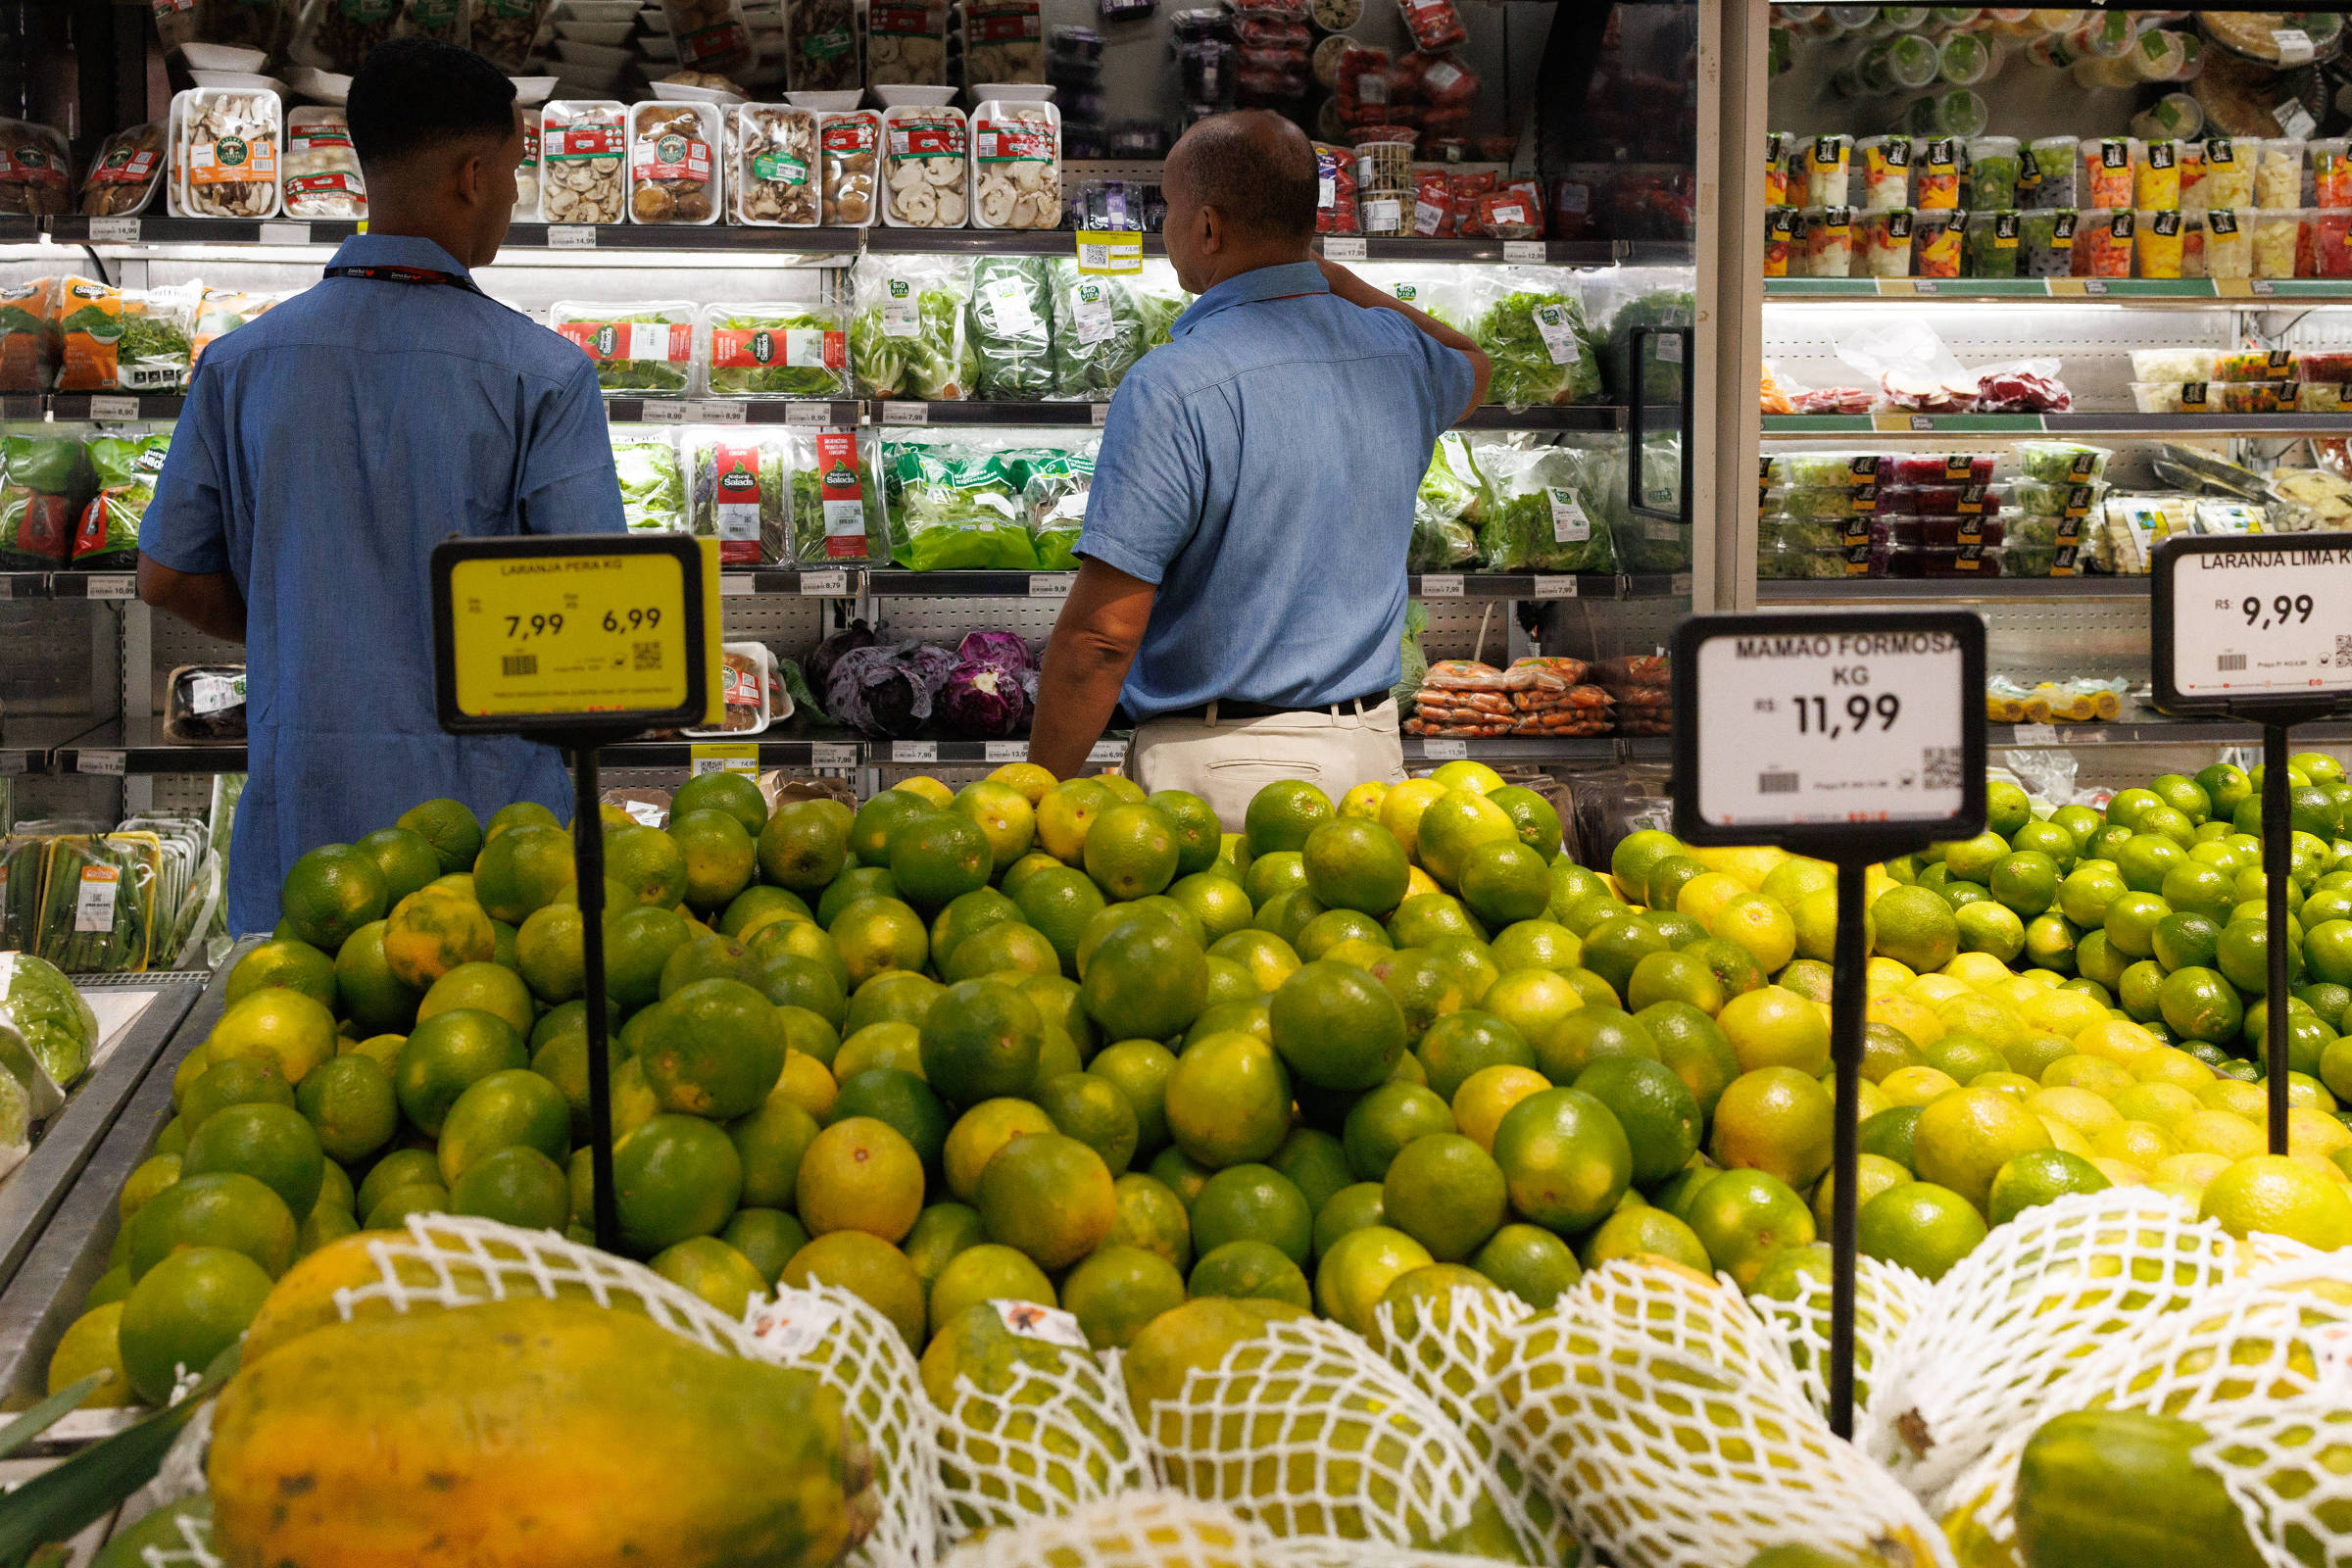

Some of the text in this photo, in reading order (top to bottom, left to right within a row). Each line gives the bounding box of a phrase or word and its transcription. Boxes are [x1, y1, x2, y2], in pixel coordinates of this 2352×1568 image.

[725, 478, 753, 486] Salads
[500, 558, 622, 576] LARANJA PERA KG
[2202, 551, 2285, 570] LARANJA
[2291, 549, 2333, 566] LIMA
[603, 608, 661, 635] 6,99
[2242, 594, 2313, 630] 9,99
[505, 613, 564, 641] 7,99
[1839, 633, 1961, 655] FORMOSA
[1832, 666, 1869, 686] KG
[1793, 693, 1901, 739] 11,99
